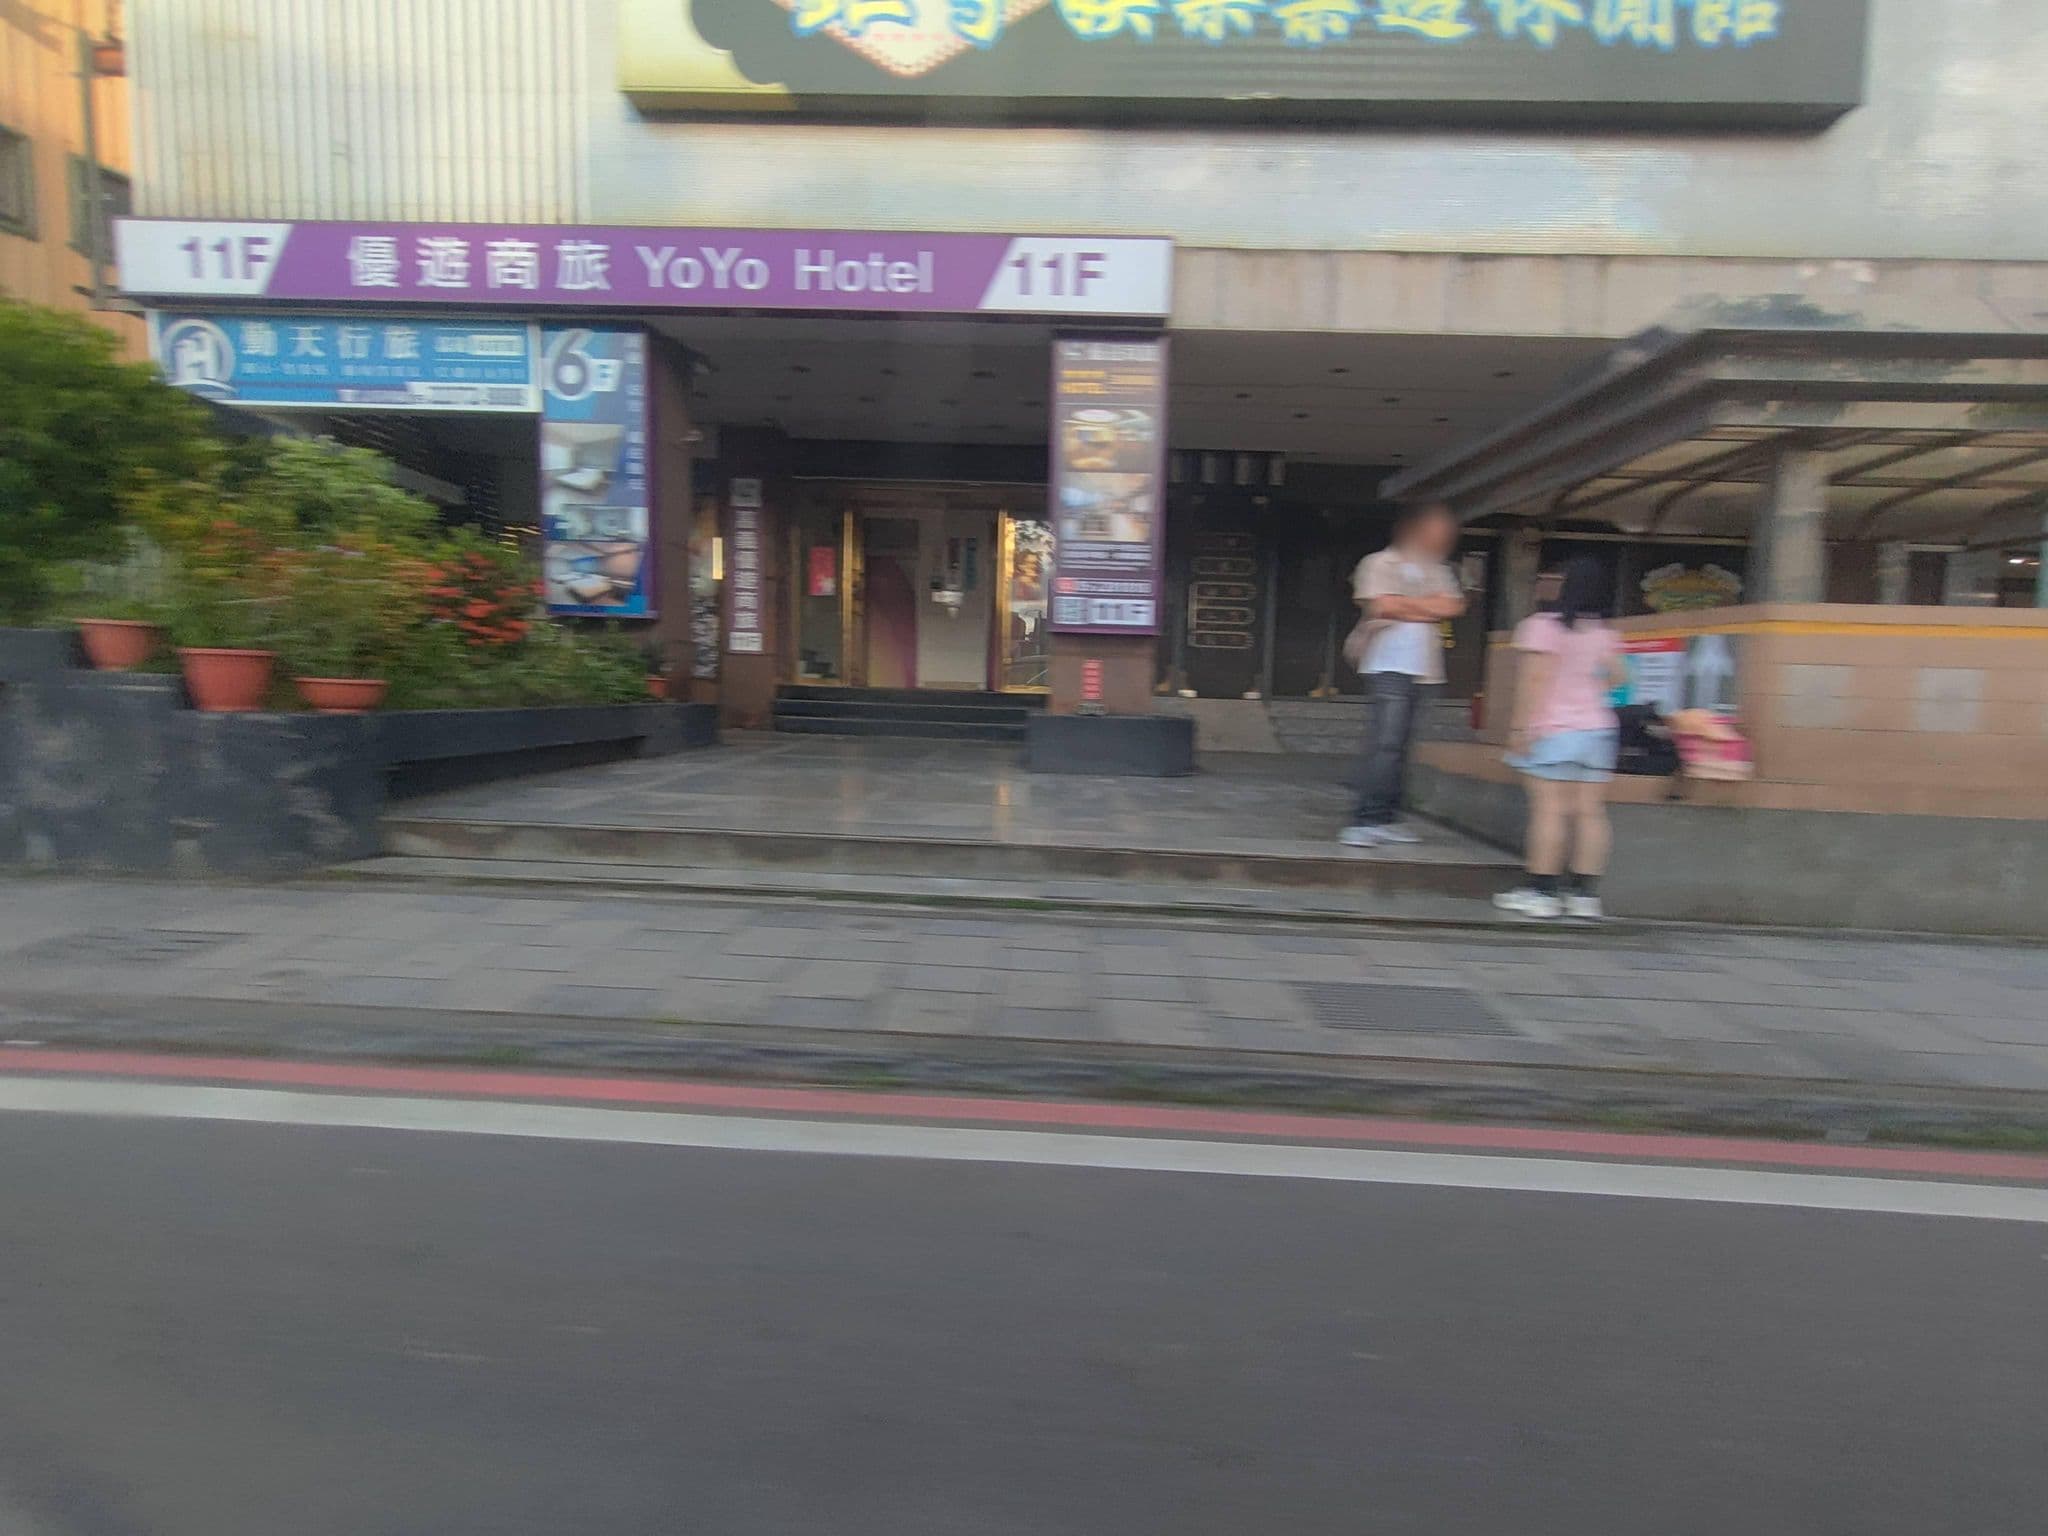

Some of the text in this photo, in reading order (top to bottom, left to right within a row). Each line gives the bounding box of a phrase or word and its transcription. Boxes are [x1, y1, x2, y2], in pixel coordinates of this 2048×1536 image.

[179, 236, 272, 281] 11F
[347, 235, 611, 291] 優遊商旅
[635, 245, 934, 294] YoYo Hotel
[1008, 251, 1109, 297] 11F
